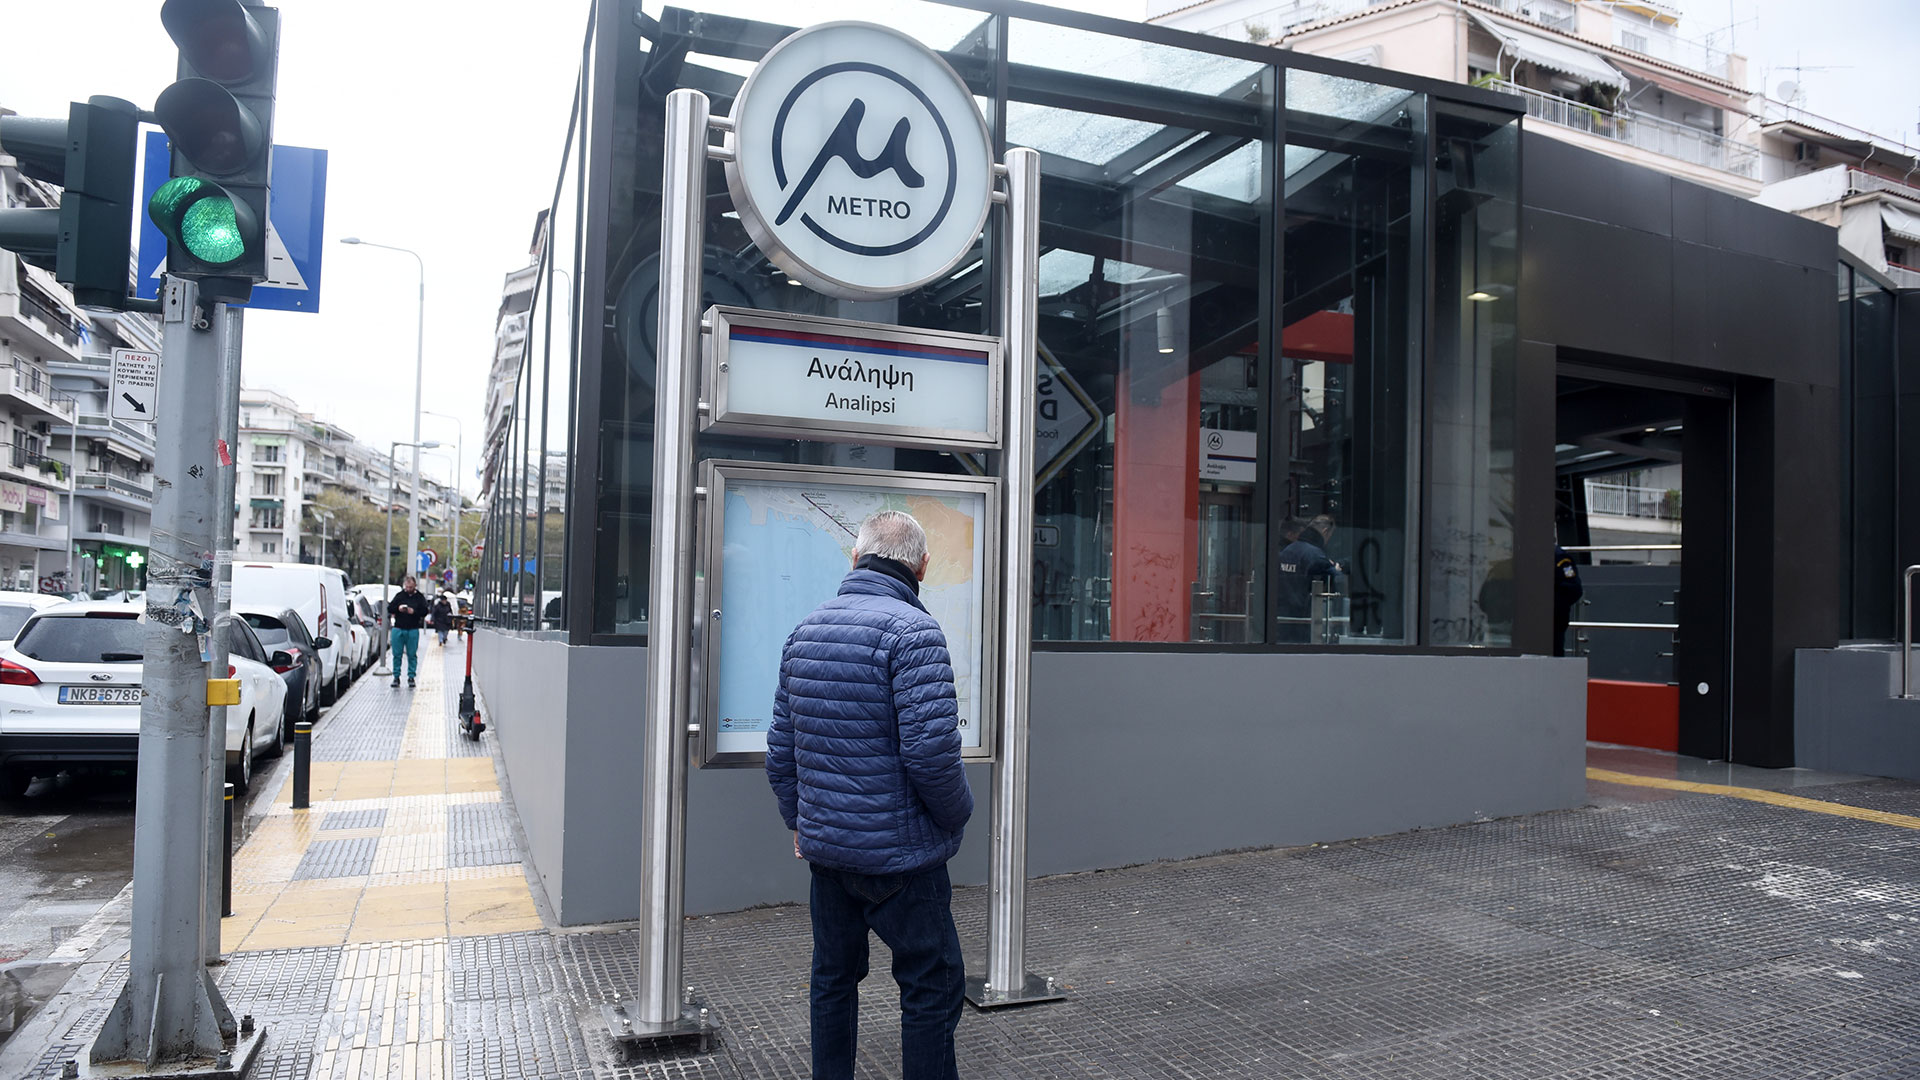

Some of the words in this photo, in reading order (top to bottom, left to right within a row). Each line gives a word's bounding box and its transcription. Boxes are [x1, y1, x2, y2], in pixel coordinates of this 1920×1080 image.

[827, 195, 911, 220] METRO
[125, 354, 151, 362] ΠΕΖΟΙ
[806, 357, 914, 392] Ανάληψη
[825, 392, 896, 416] Analipsi
[1, 483, 24, 511] baby
